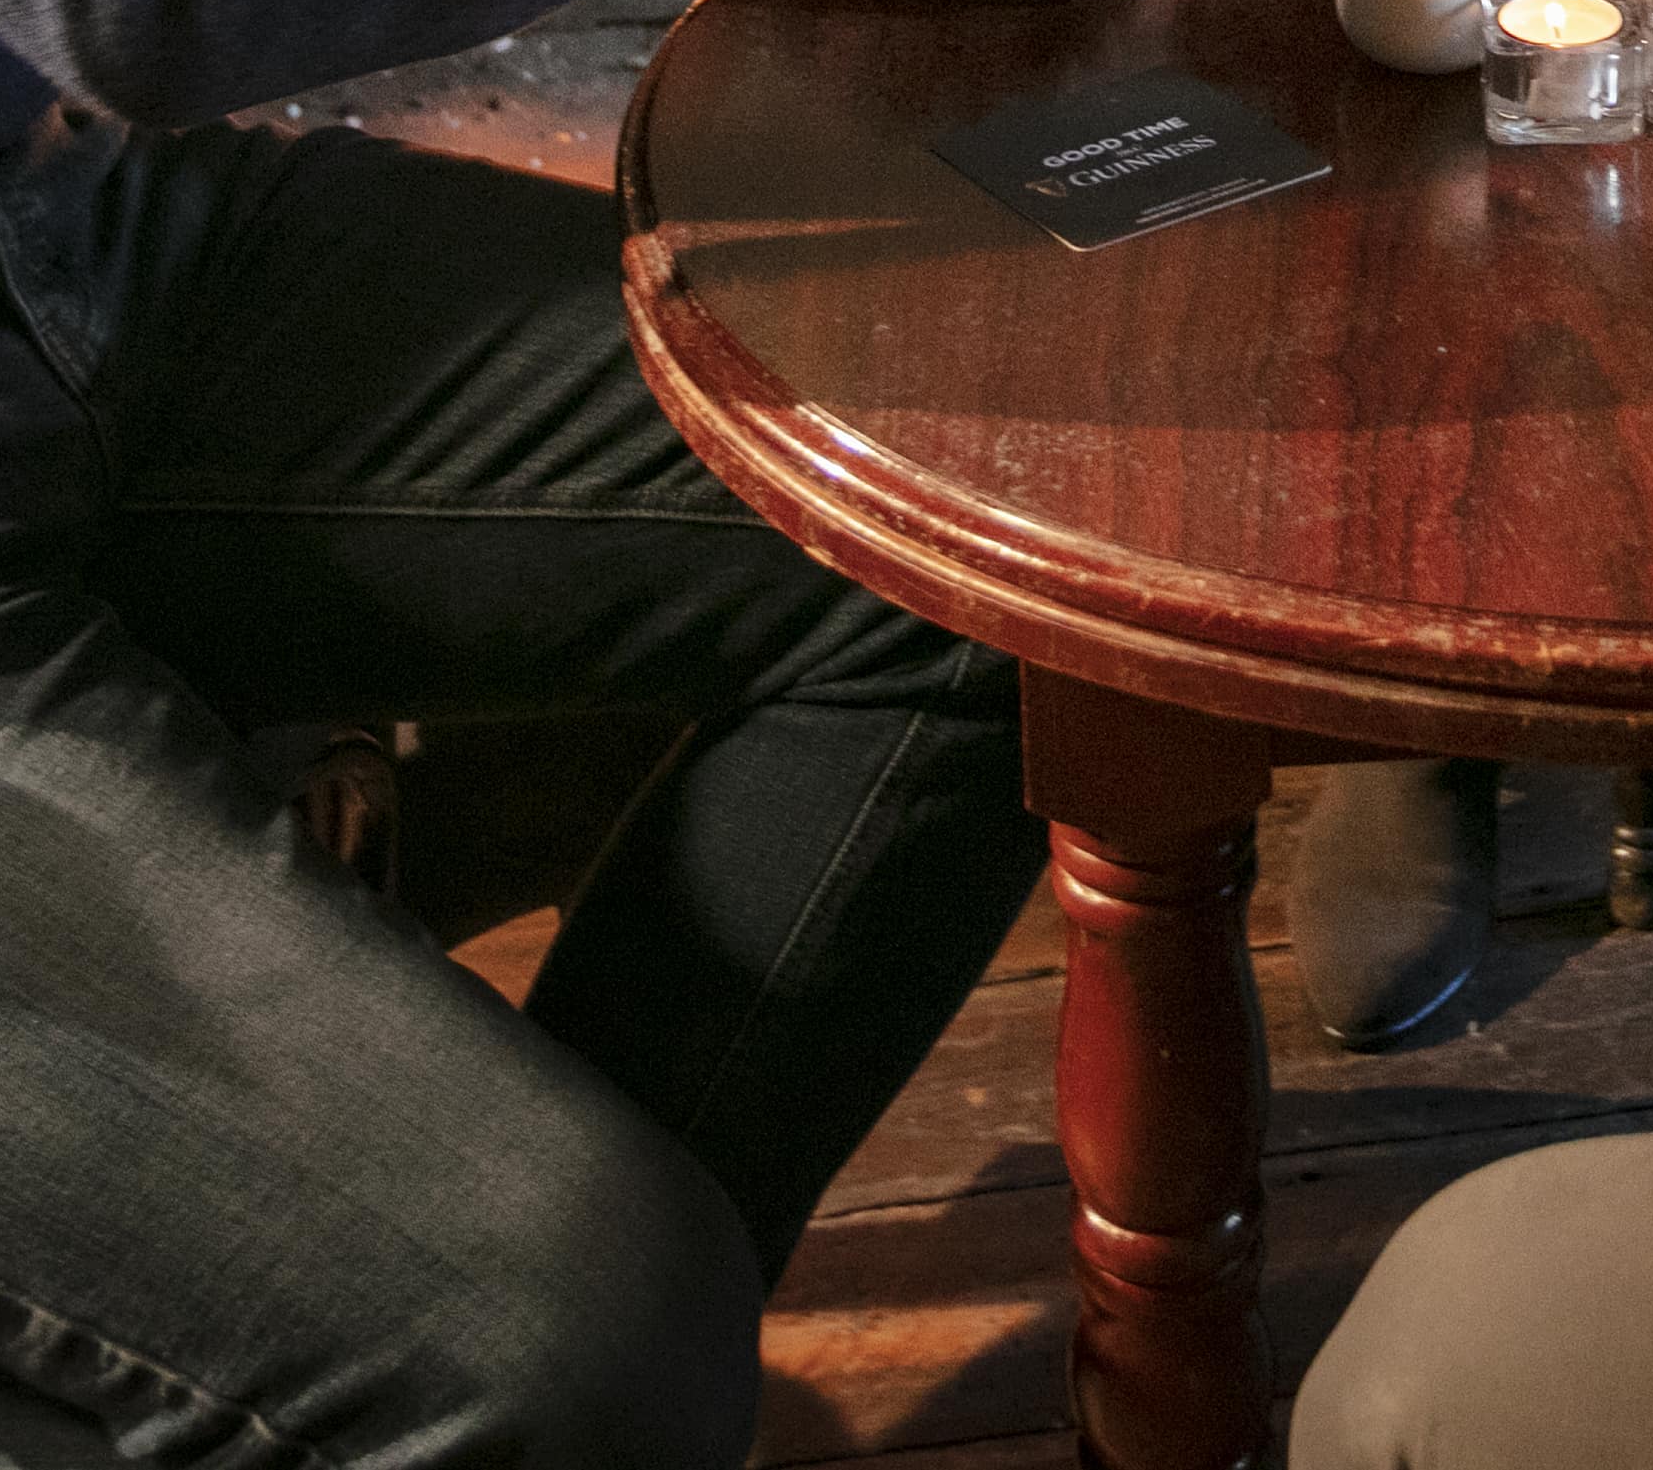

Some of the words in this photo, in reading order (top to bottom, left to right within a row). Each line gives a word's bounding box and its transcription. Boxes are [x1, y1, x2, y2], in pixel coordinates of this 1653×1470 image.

[1042, 136, 1123, 168] GOOD
[1121, 115, 1190, 141] TIME
[1068, 134, 1217, 187] GUINNESS
